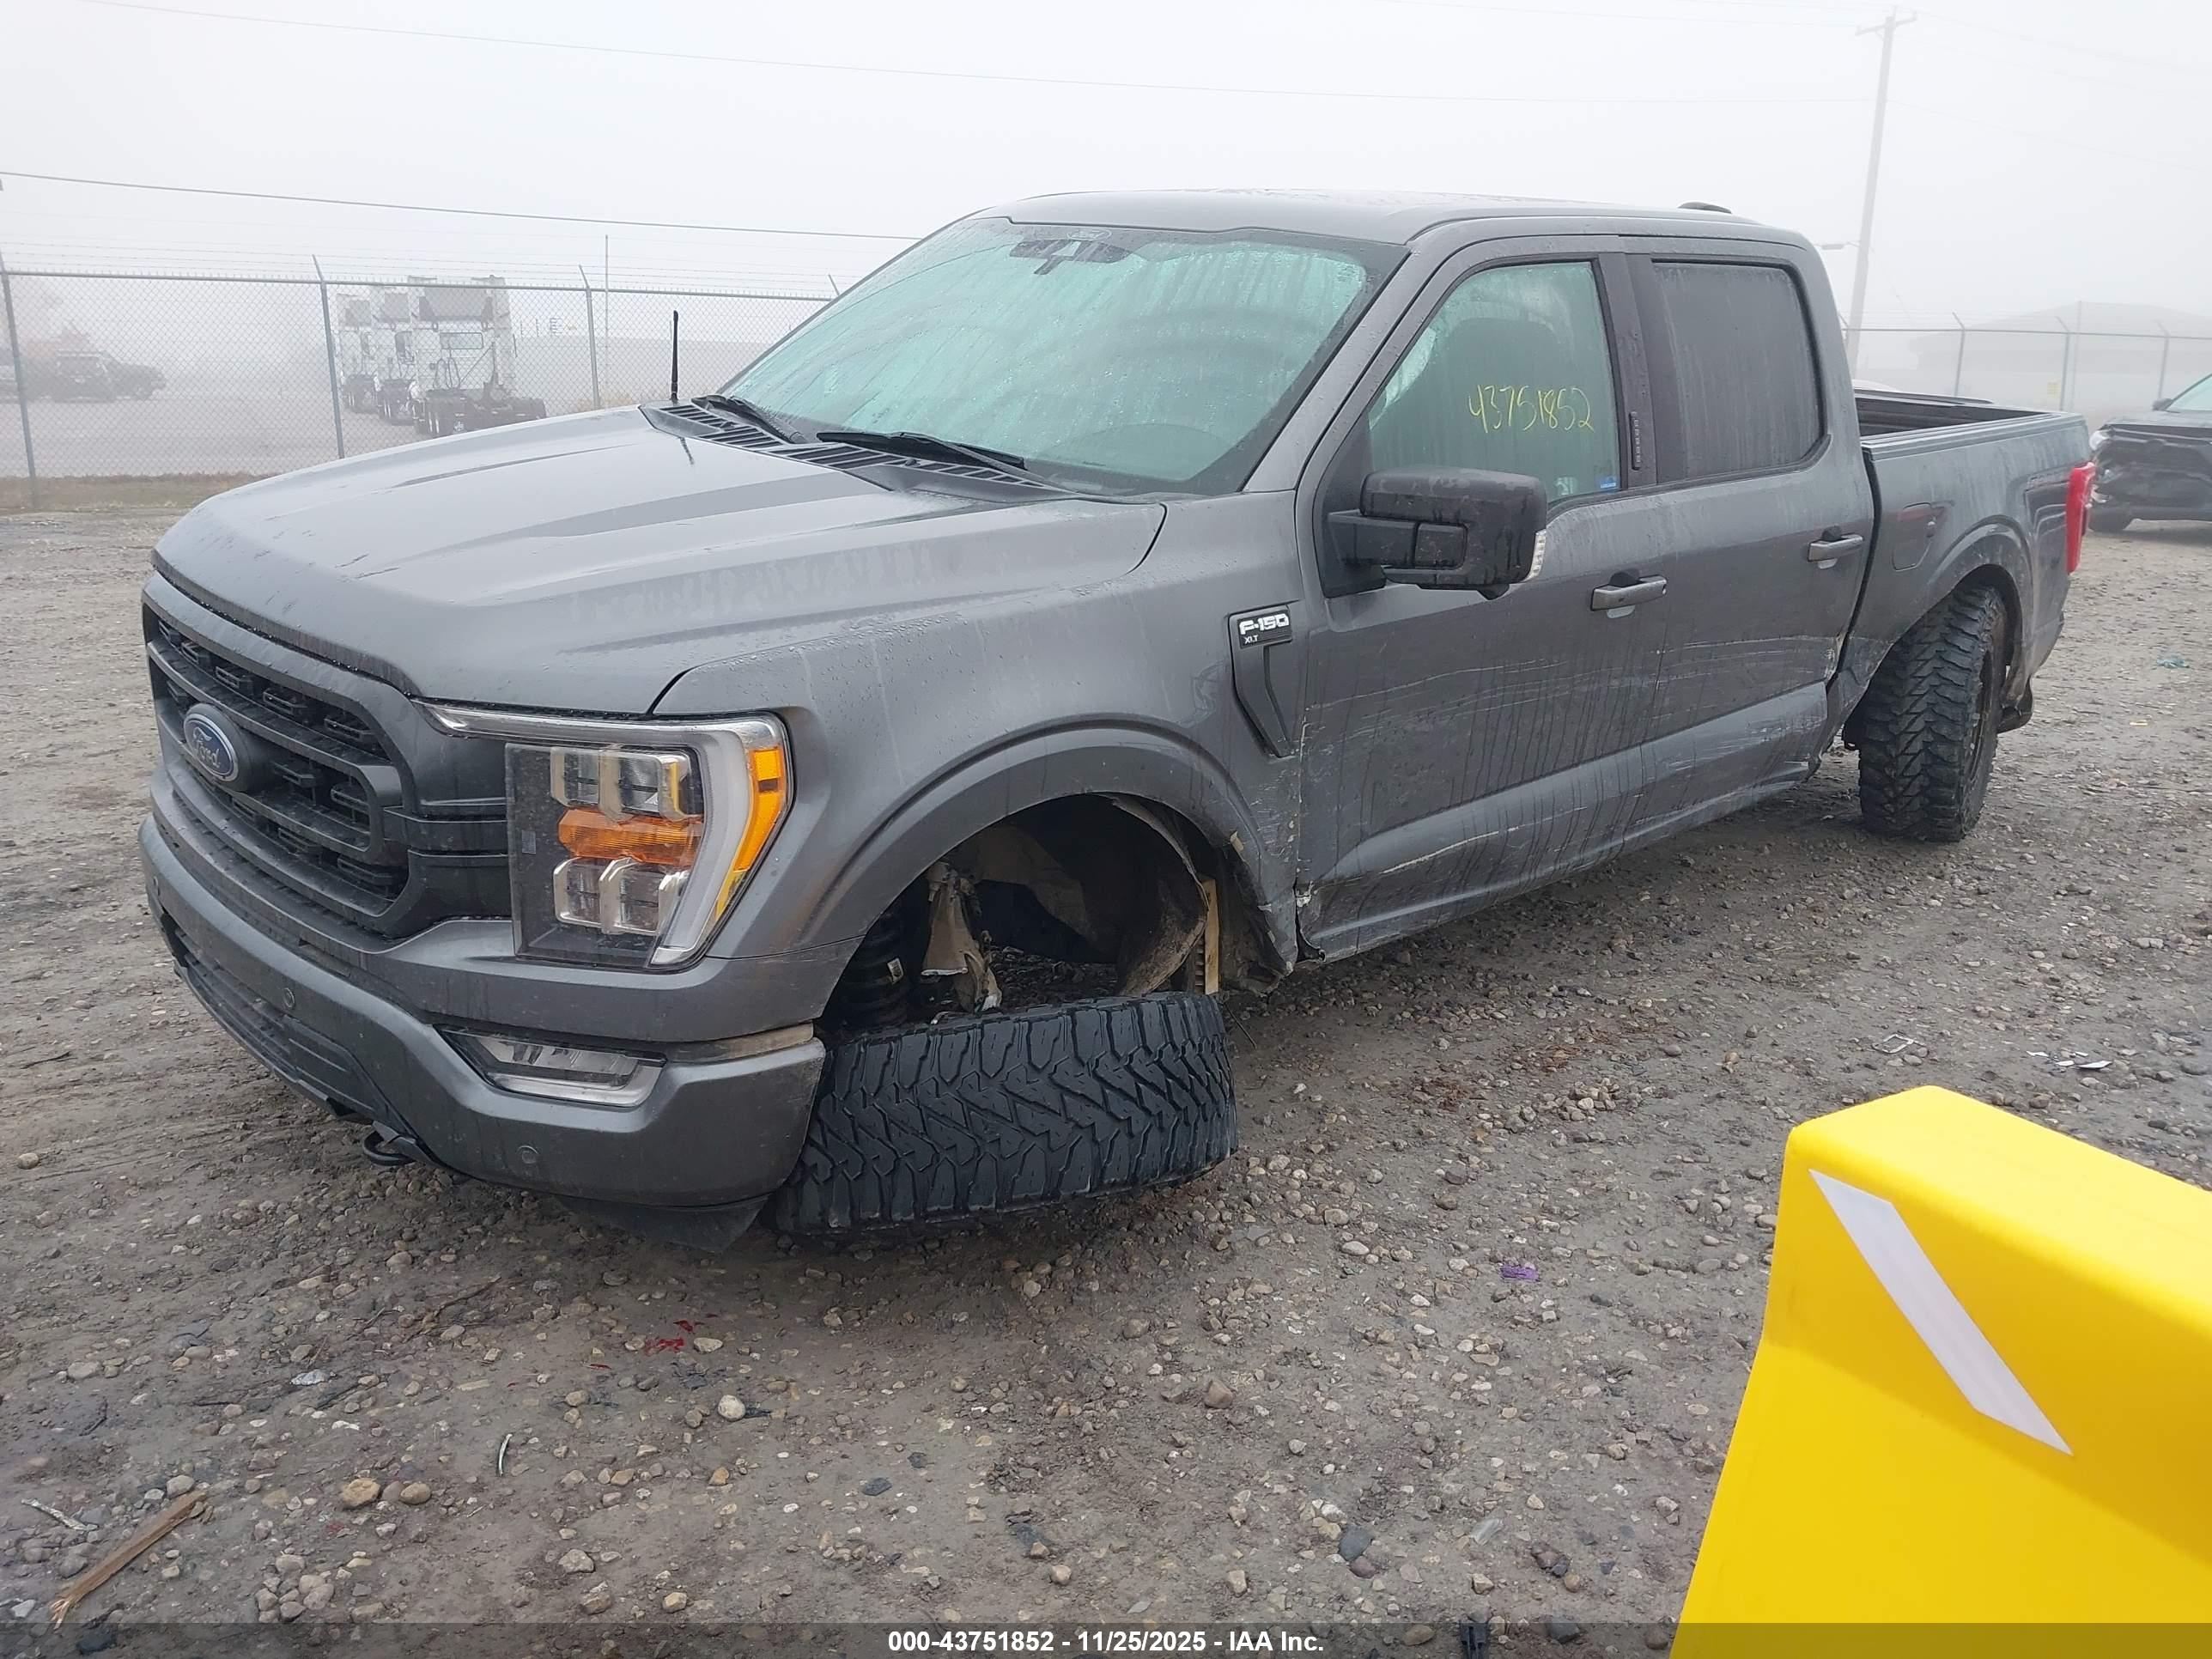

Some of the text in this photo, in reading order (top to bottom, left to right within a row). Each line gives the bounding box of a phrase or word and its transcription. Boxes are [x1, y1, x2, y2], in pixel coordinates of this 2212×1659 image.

[1468, 385, 1595, 433] 43751852
[1239, 613, 1289, 635] F-150
[1244, 635, 1259, 644] XLT
[192, 726, 222, 769] Ford
